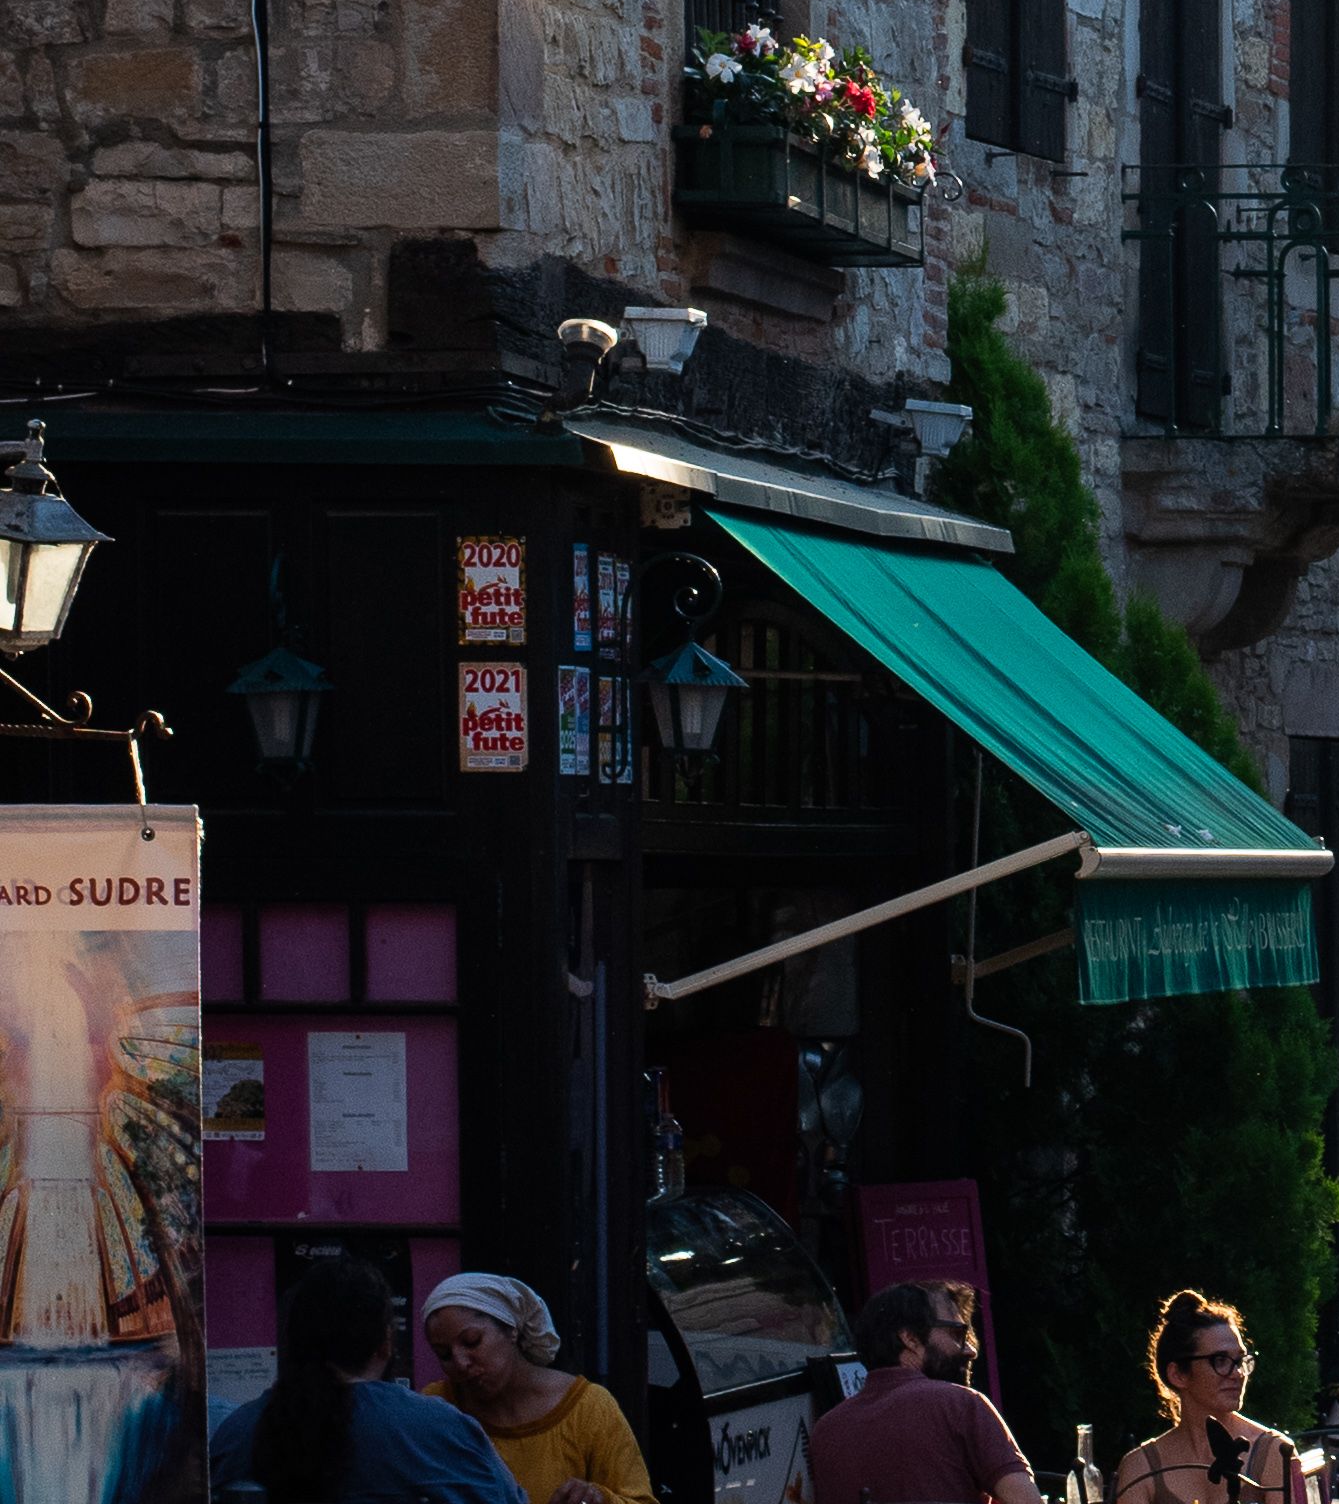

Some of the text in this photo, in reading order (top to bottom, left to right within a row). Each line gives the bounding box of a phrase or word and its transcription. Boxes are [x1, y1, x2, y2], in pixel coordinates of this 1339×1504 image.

[462, 543, 521, 568] 2020
[461, 586, 523, 611] petit
[464, 669, 520, 693] 2021
[462, 711, 525, 737] petit
[70, 877, 192, 907] SUDRE
[872, 1218, 972, 1263] TERRASSE
